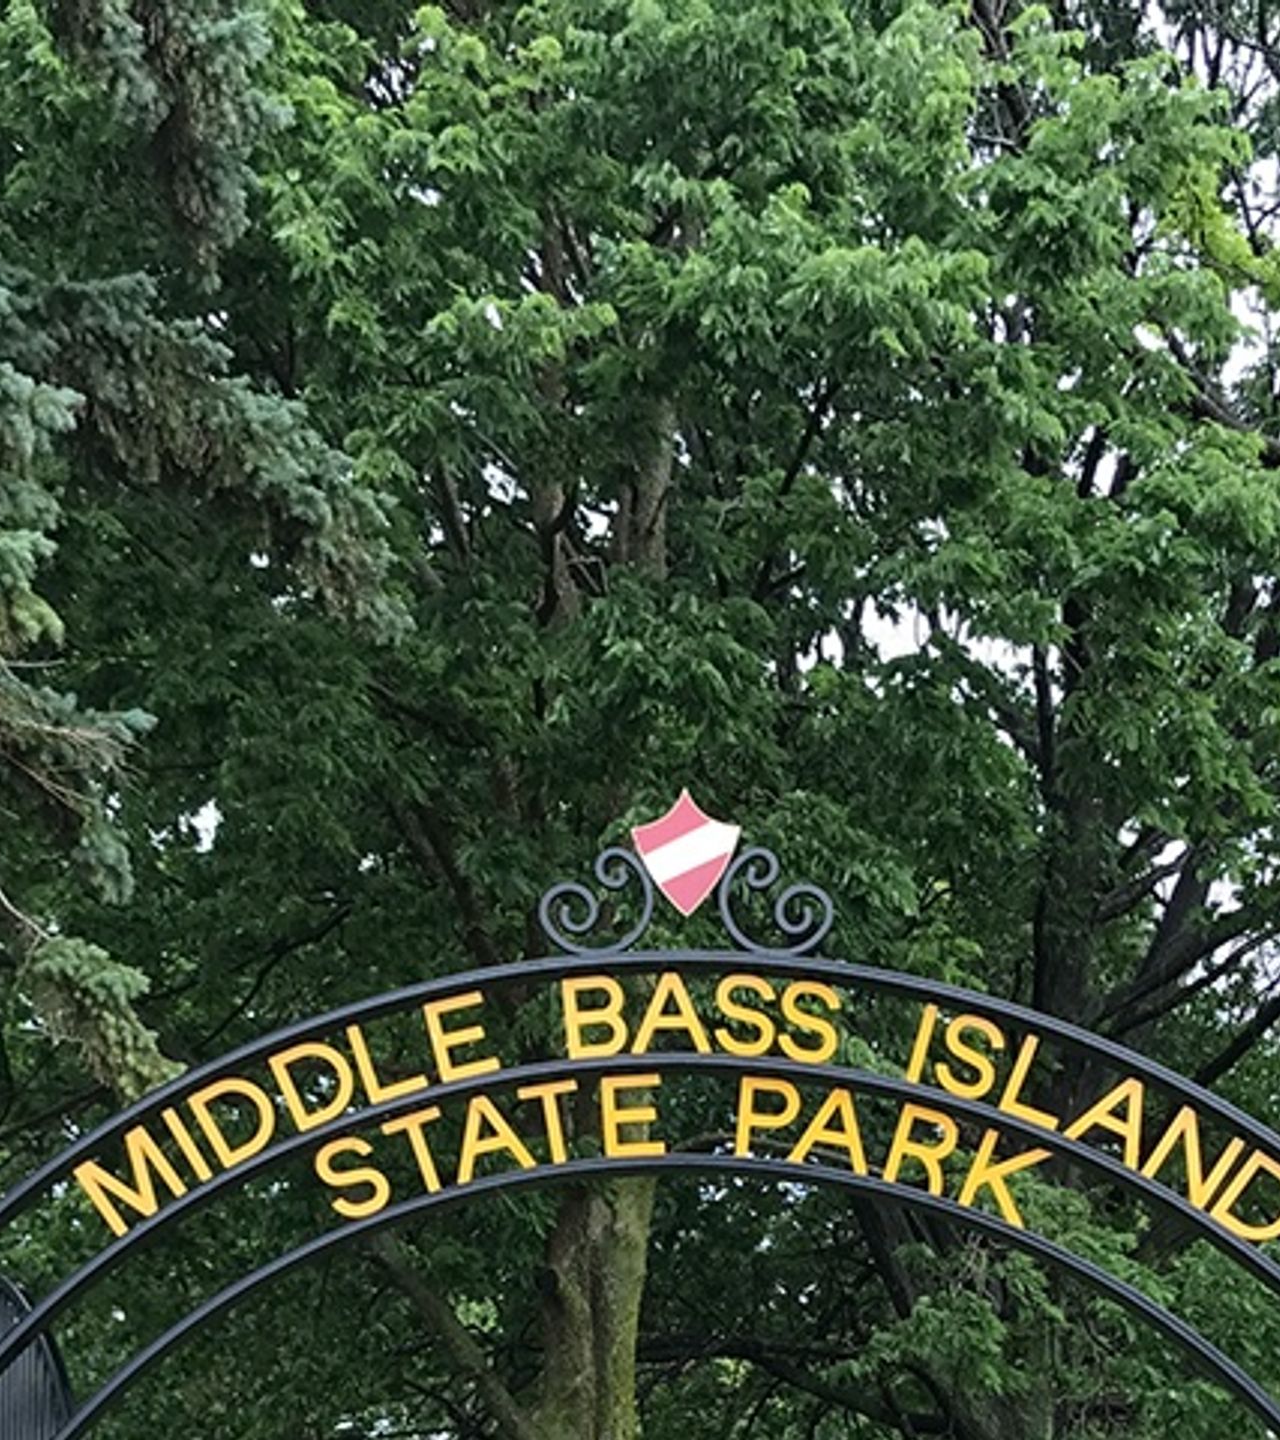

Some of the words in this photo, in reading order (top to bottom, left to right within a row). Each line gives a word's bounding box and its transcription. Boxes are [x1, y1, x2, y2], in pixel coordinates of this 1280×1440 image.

[72, 990, 501, 1236] MIDDLE
[561, 972, 841, 1064] BASS
[315, 1073, 666, 1218] STATE
[734, 1076, 1054, 1229] PARK
